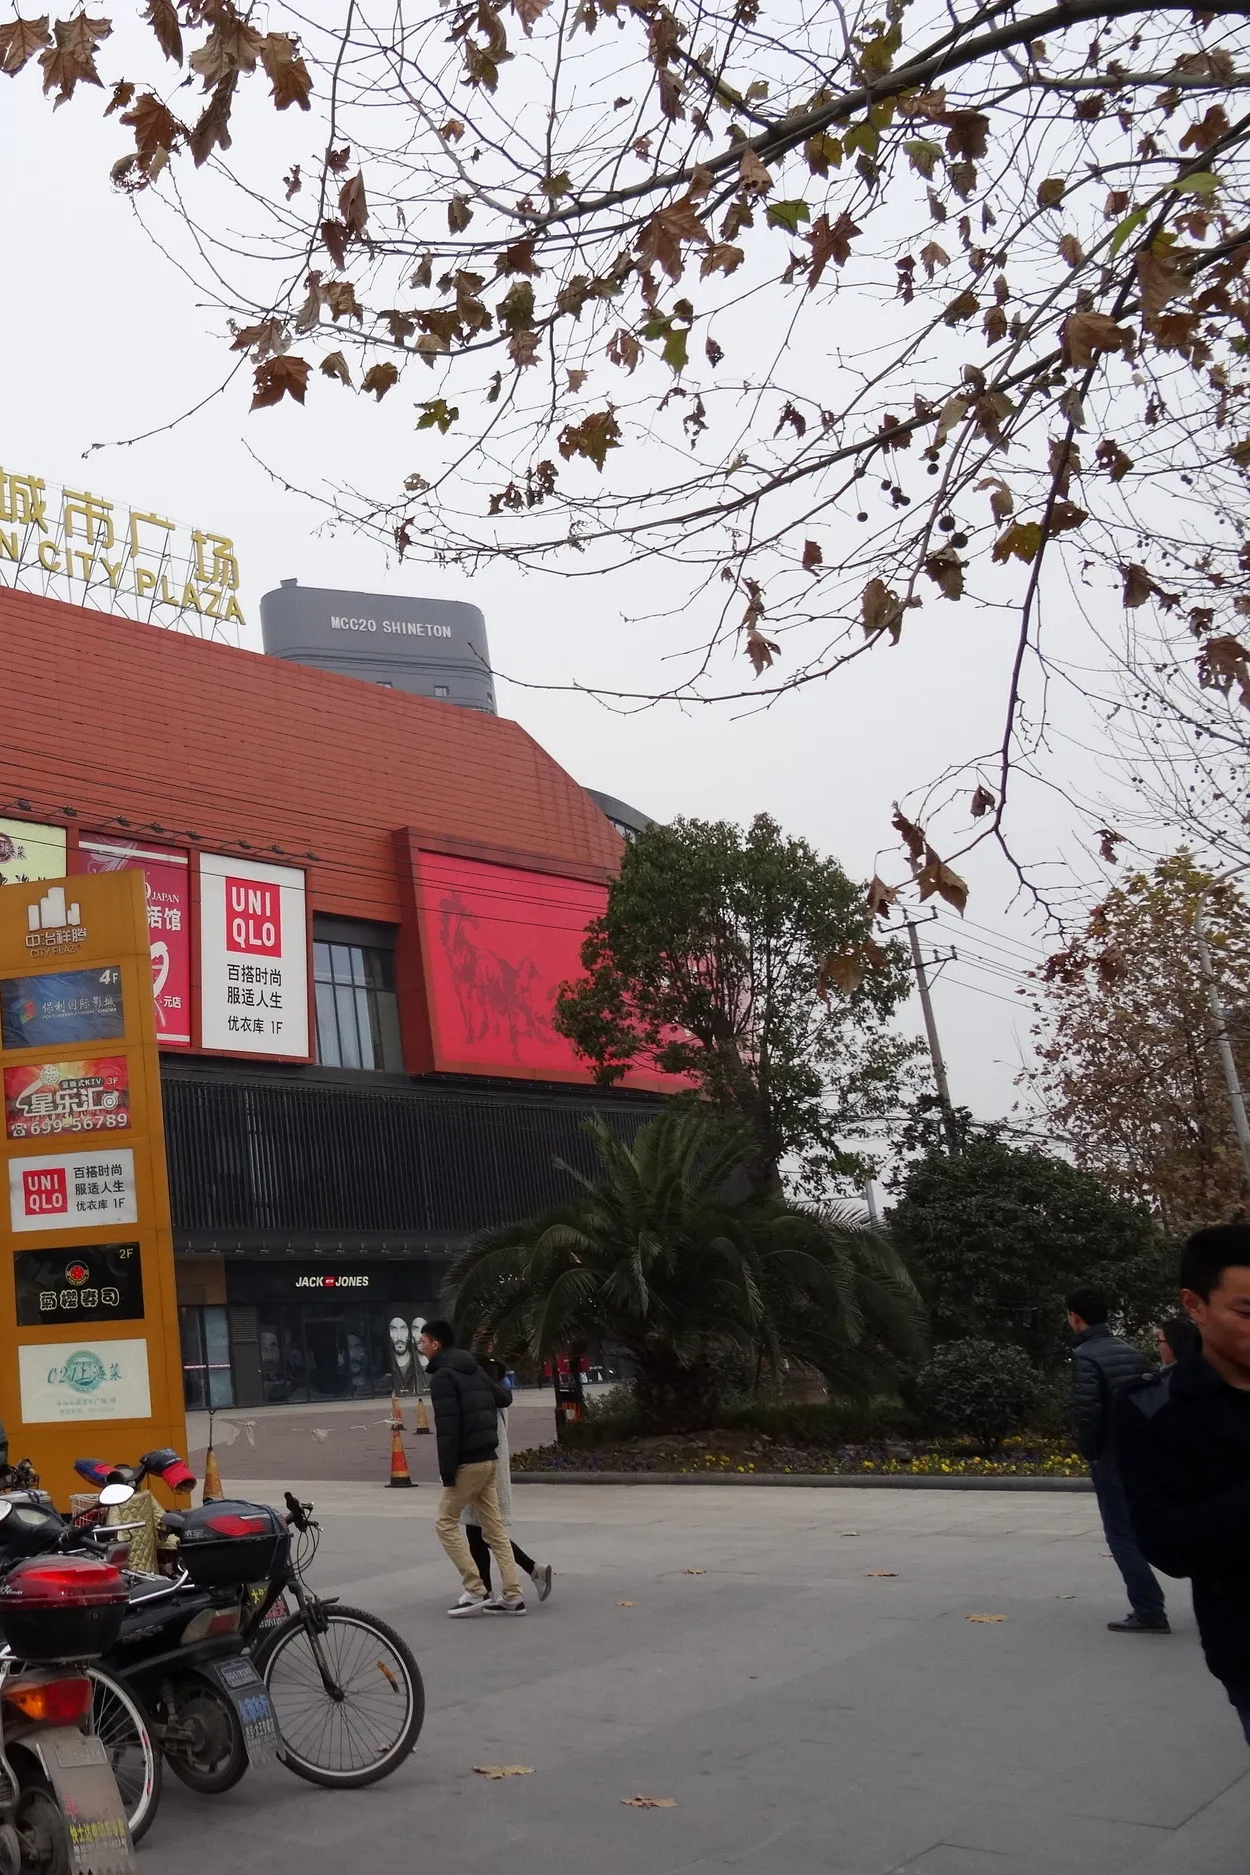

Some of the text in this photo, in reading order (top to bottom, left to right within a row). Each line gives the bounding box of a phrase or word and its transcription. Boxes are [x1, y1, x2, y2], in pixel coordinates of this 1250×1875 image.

[38, 540, 124, 590] CITY
[137, 567, 246, 626] PLAZA
[330, 616, 452, 639] MCC20 SHINETON
[151, 891, 180, 904] JAPAN
[231, 886, 271, 917] UNI
[25, 928, 87, 947] 中冶祥腾
[232, 917, 275, 948] QLO
[30, 944, 81, 958] CITY PLAZ
[99, 969, 119, 985] 4F
[227, 963, 282, 987] 百搭时尚
[163, 995, 182, 1009] 元店
[227, 986, 283, 1010] 服适人生
[227, 1015, 283, 1035] 优衣库 1F
[107, 1076, 119, 1085] 3F
[30, 1113, 128, 1135] 699-56789
[73, 1164, 123, 1179] 百搭时尚
[28, 1174, 59, 1192] UNI
[75, 1181, 125, 1196] 服适人生
[29, 1192, 63, 1212] QLO
[76, 1197, 126, 1212] 优衣库 1F
[119, 1248, 134, 1259] 2F
[295, 1275, 369, 1288] JACK JONES
